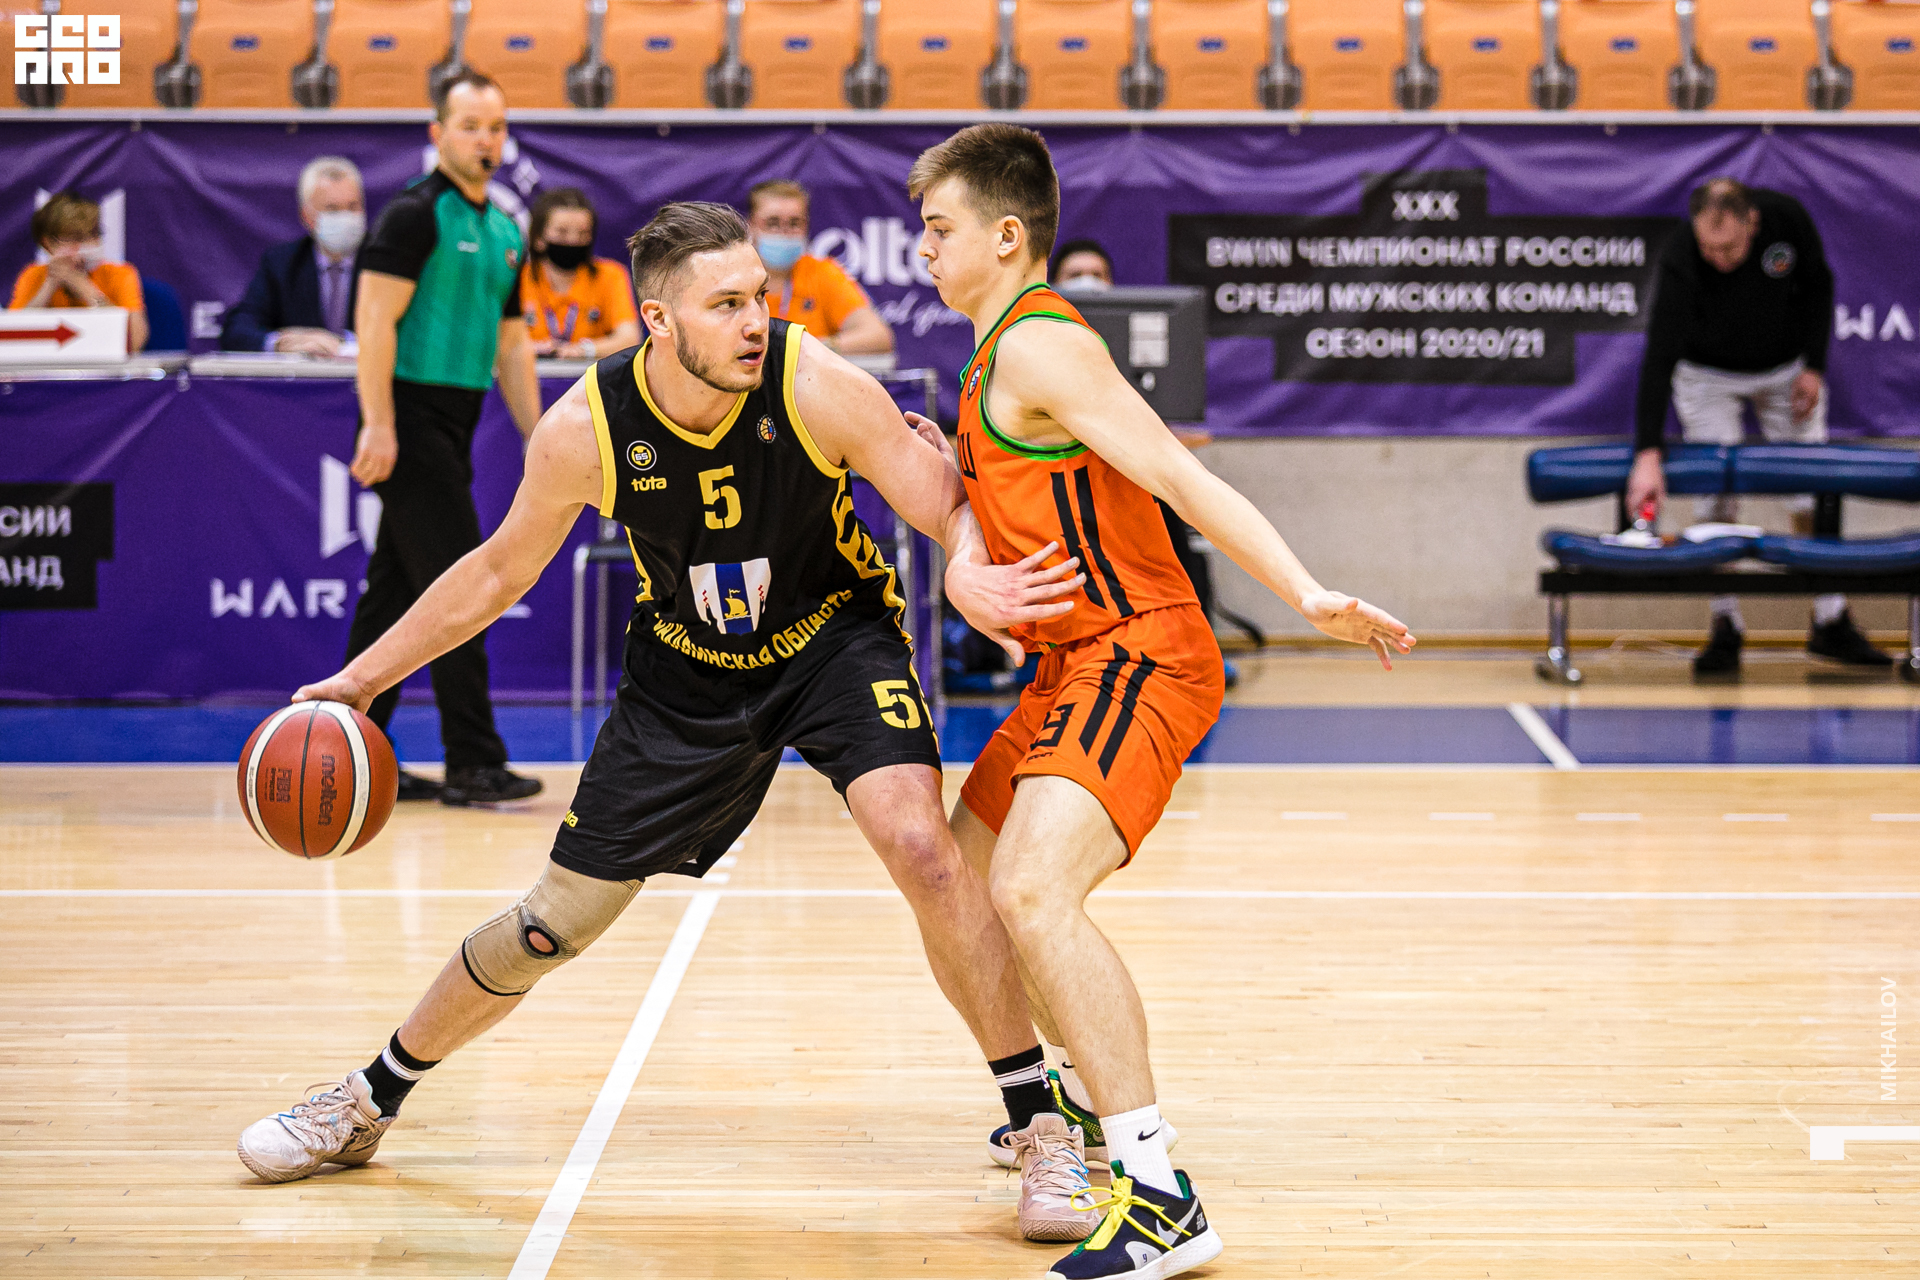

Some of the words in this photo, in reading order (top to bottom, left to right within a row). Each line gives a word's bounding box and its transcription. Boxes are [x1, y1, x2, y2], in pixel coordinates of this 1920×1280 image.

[1297, 236, 1500, 267] ЧЕМПИОНАТ
[1505, 236, 1646, 267] РОССИИ
[1215, 282, 1324, 317] СРЕДИ
[1328, 282, 1491, 313] МУЖСКИХ
[1495, 282, 1639, 316] КОМАНД
[1305, 327, 1418, 358] СЕЗОН
[1421, 325, 1545, 361] 2020/21
[698, 464, 742, 530] 5
[0, 505, 72, 537] СИИ
[772, 589, 853, 659] ОБЛАСТЬ
[871, 679, 922, 729] 5
[317, 754, 337, 826] molten
